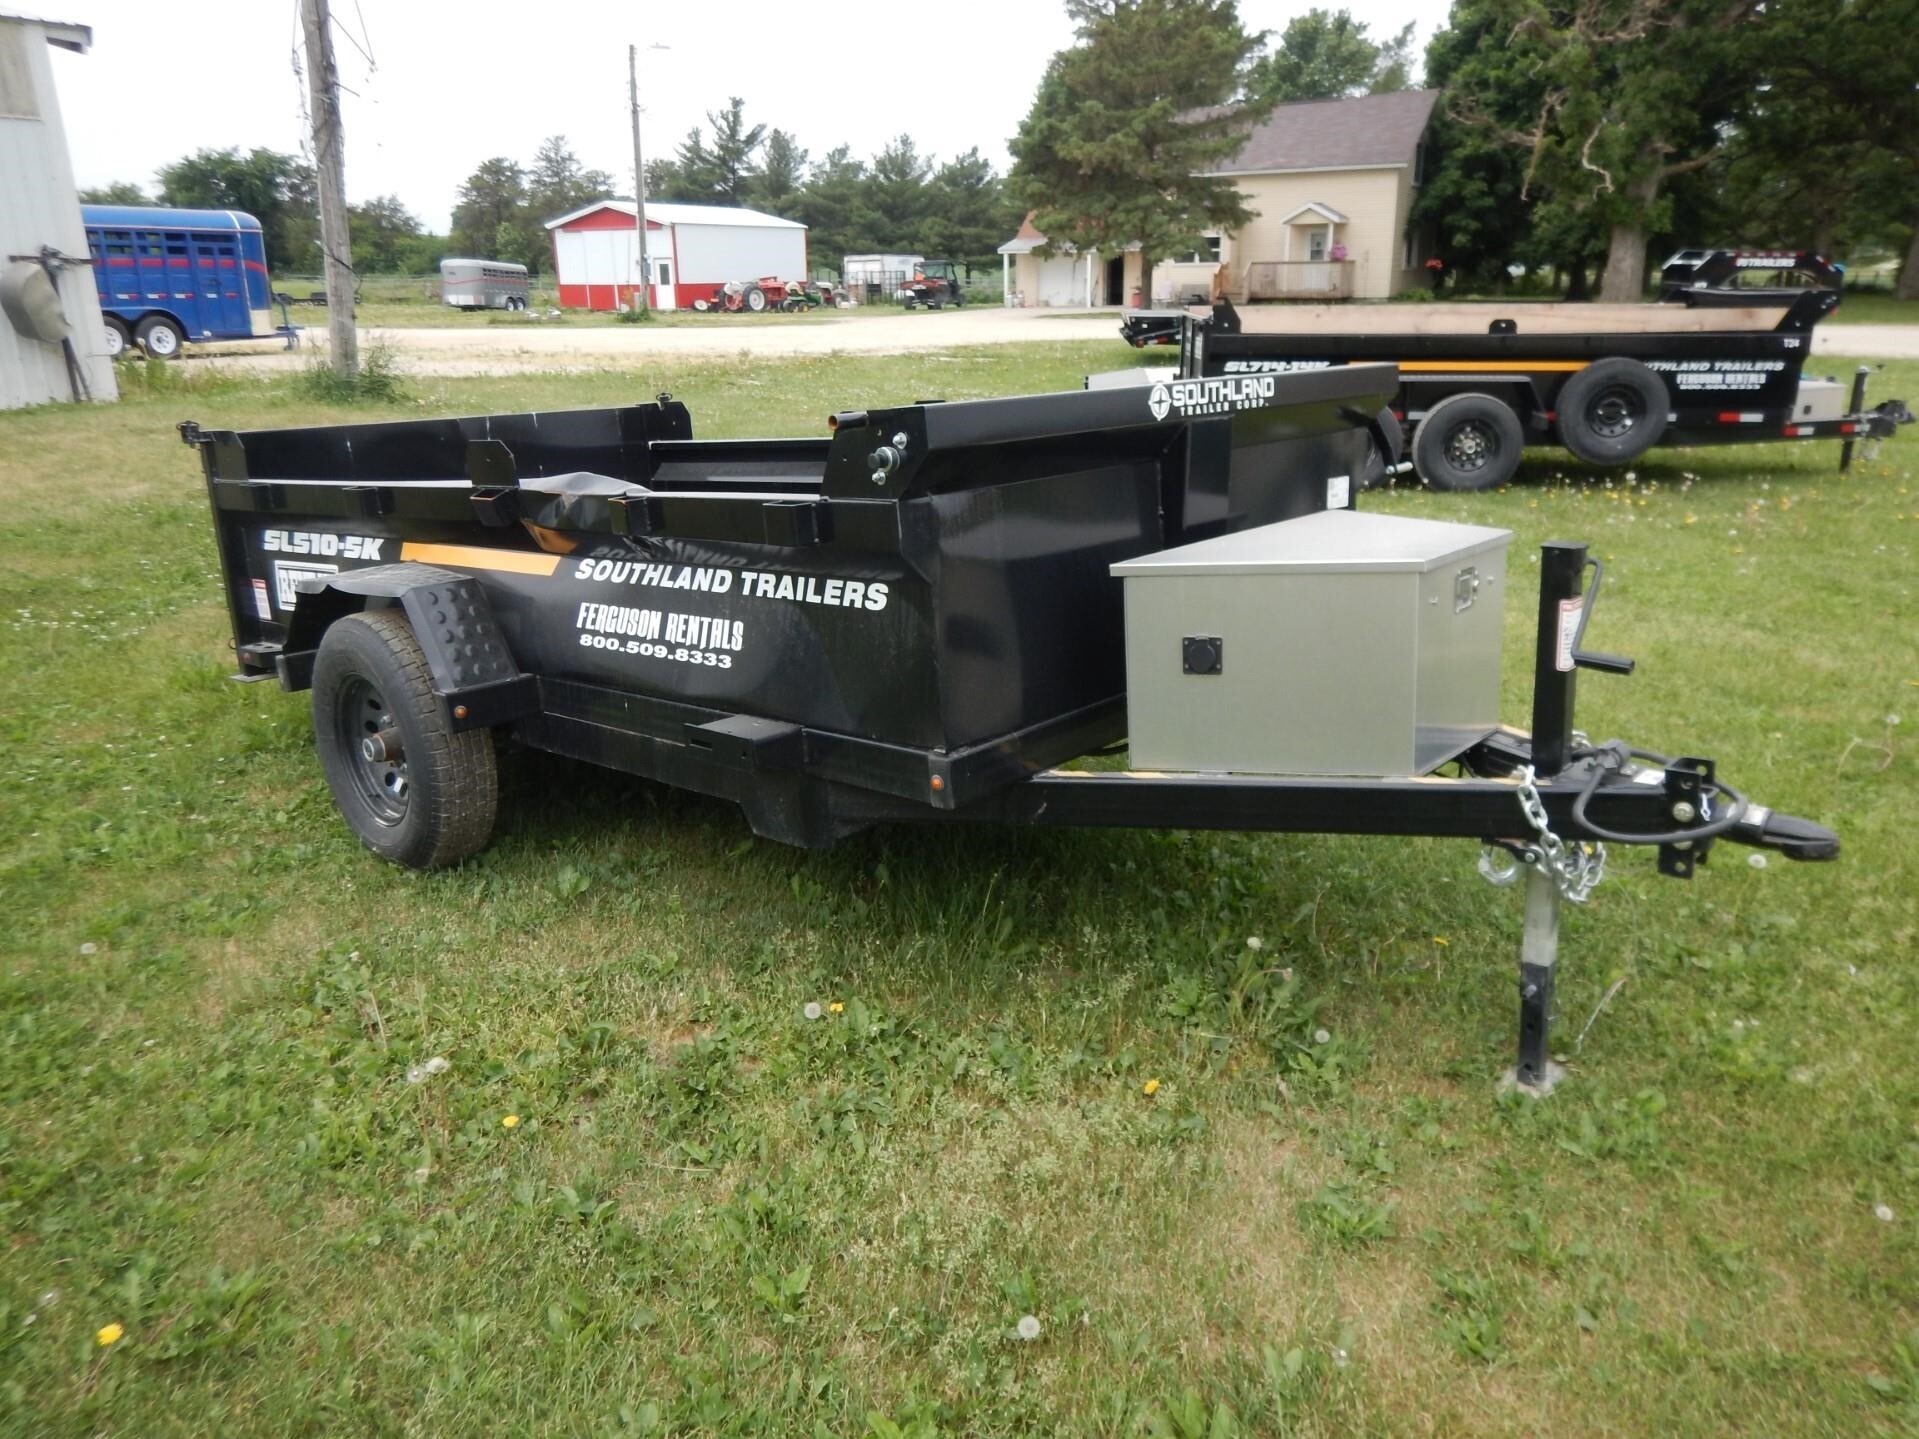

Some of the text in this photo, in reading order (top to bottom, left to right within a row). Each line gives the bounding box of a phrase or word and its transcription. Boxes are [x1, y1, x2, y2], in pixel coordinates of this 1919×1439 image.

[1644, 361, 1785, 371] THLAND TRAILERS
[1172, 377, 1275, 407] SOUTHLAND
[1180, 401, 1230, 416] TRAILER
[263, 529, 385, 561] SL510-5K
[574, 558, 889, 611] SOUTHLAND TRAILERS
[576, 602, 744, 651] FERGUSON RENTALS
[579, 633, 732, 669] 800.509.8333
